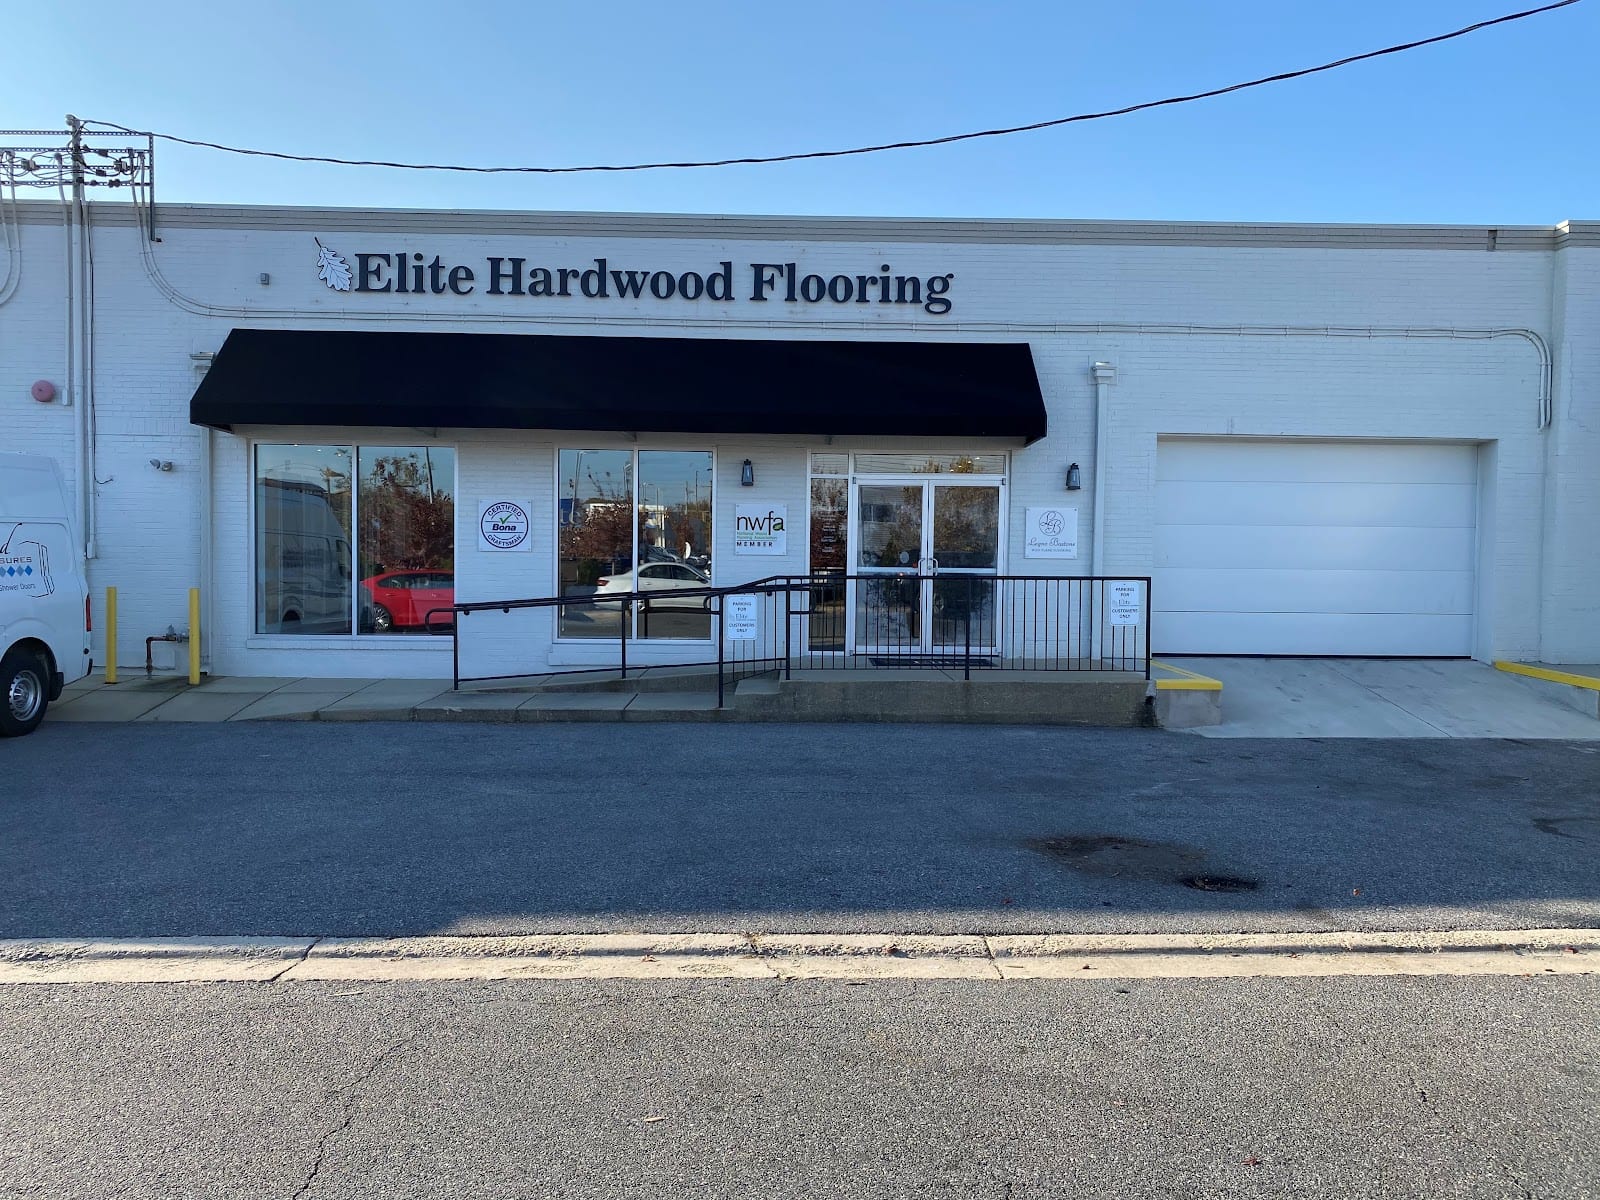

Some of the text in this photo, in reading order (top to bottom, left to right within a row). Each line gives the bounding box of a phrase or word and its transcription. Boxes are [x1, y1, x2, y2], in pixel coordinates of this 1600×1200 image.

[354, 252, 955, 315] Elite Hardwood Flooring
[487, 504, 522, 517] CERTIFIED
[492, 523, 517, 531] Bona
[736, 510, 785, 536] nwfa
[487, 534, 522, 547] CRAFTSMAN
